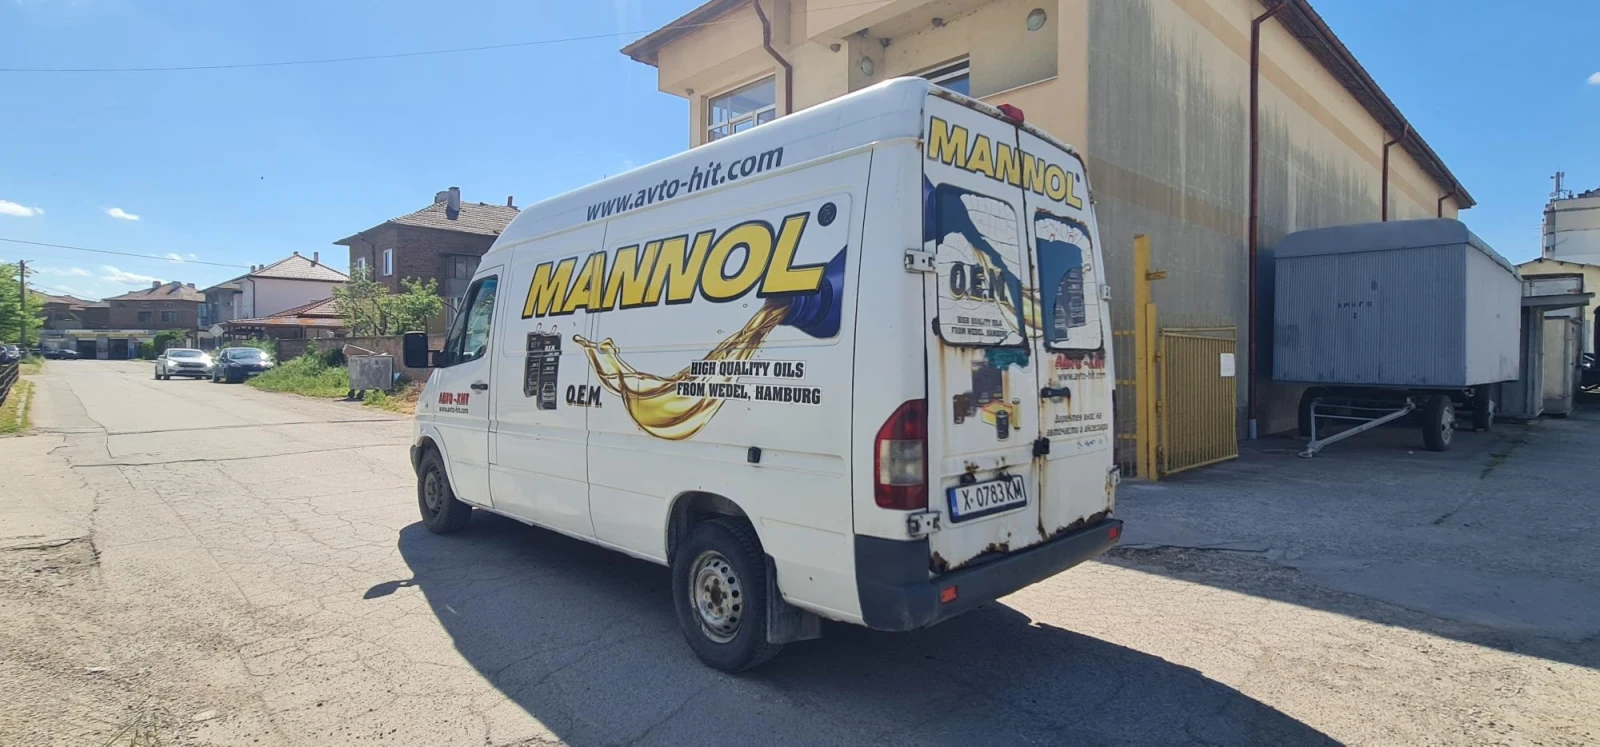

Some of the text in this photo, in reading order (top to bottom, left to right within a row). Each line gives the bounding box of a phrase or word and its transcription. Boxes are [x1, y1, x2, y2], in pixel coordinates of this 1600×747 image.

[586, 146, 784, 222] www.avto-hit.com
[927, 115, 1082, 210] MANNOL
[521, 211, 828, 319] MANNOL
[676, 382, 821, 404] FROM WEDEL, HAMBURG
[690, 361, 804, 378] HIGH QUALITY OILS
[565, 384, 603, 409] O.E.M.
